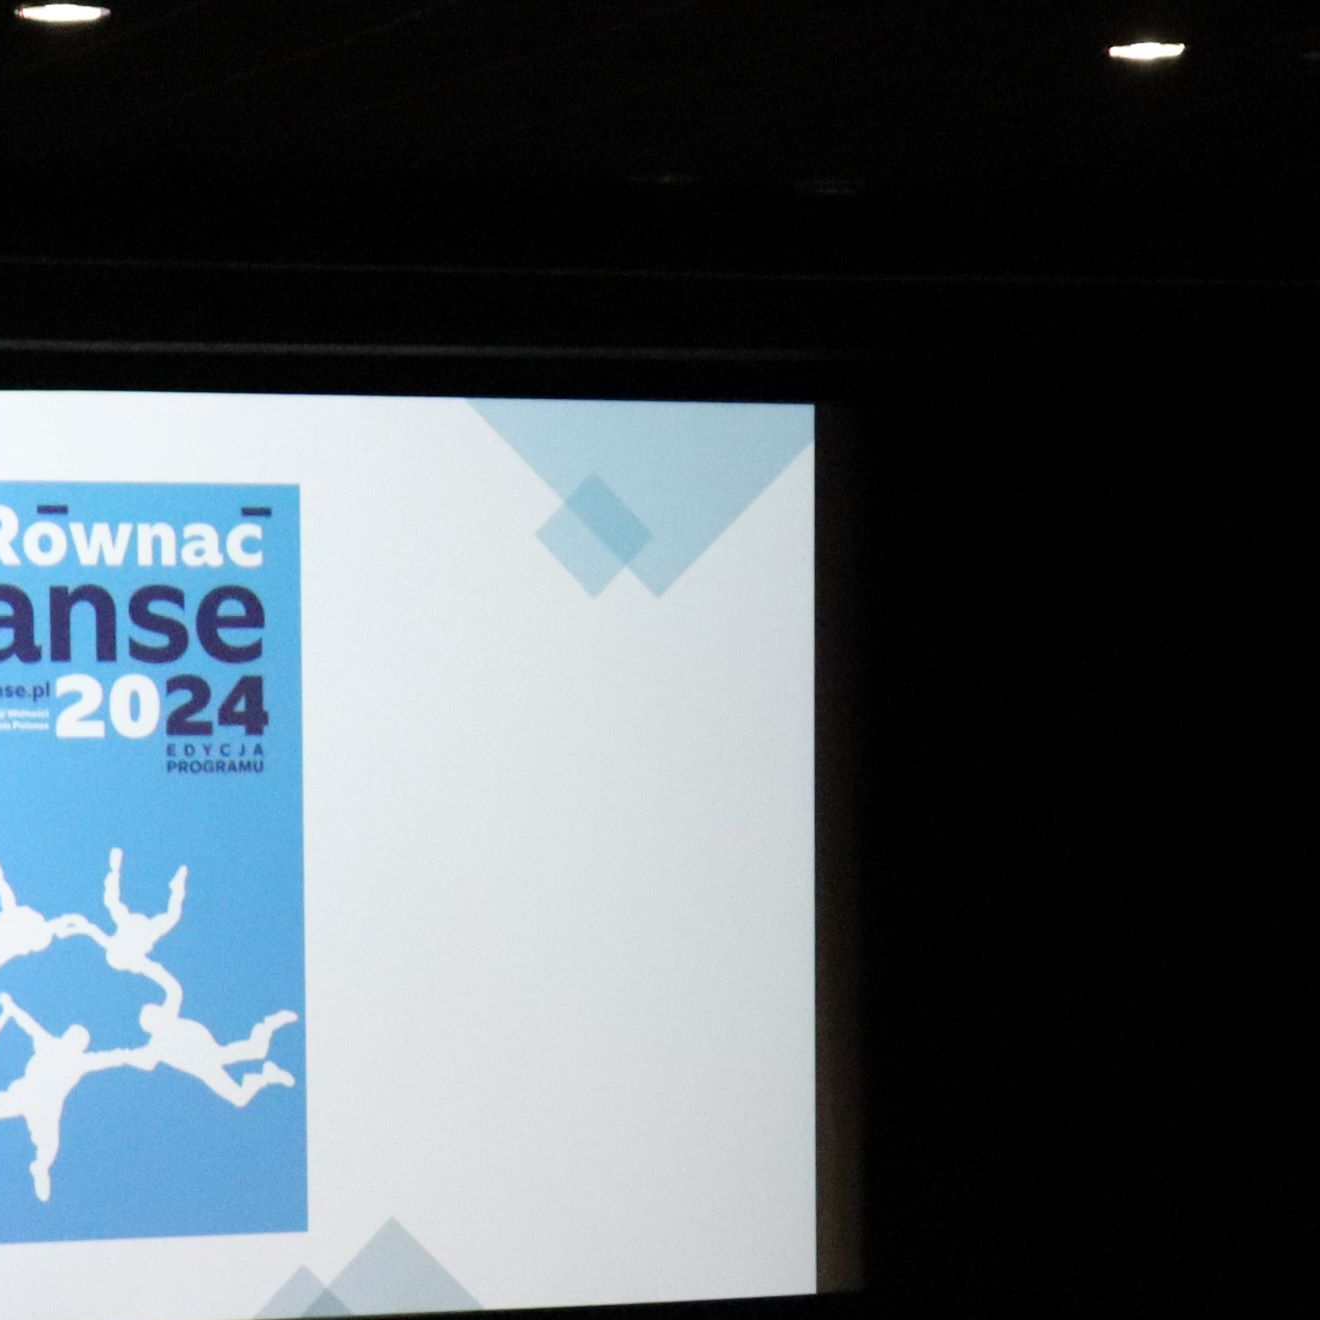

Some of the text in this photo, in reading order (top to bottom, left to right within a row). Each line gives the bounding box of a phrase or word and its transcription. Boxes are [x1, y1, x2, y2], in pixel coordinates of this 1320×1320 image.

[54, 673, 269, 738] 2024
[166, 744, 264, 757] EDYCJA
[166, 760, 264, 773] PROGRAMU
